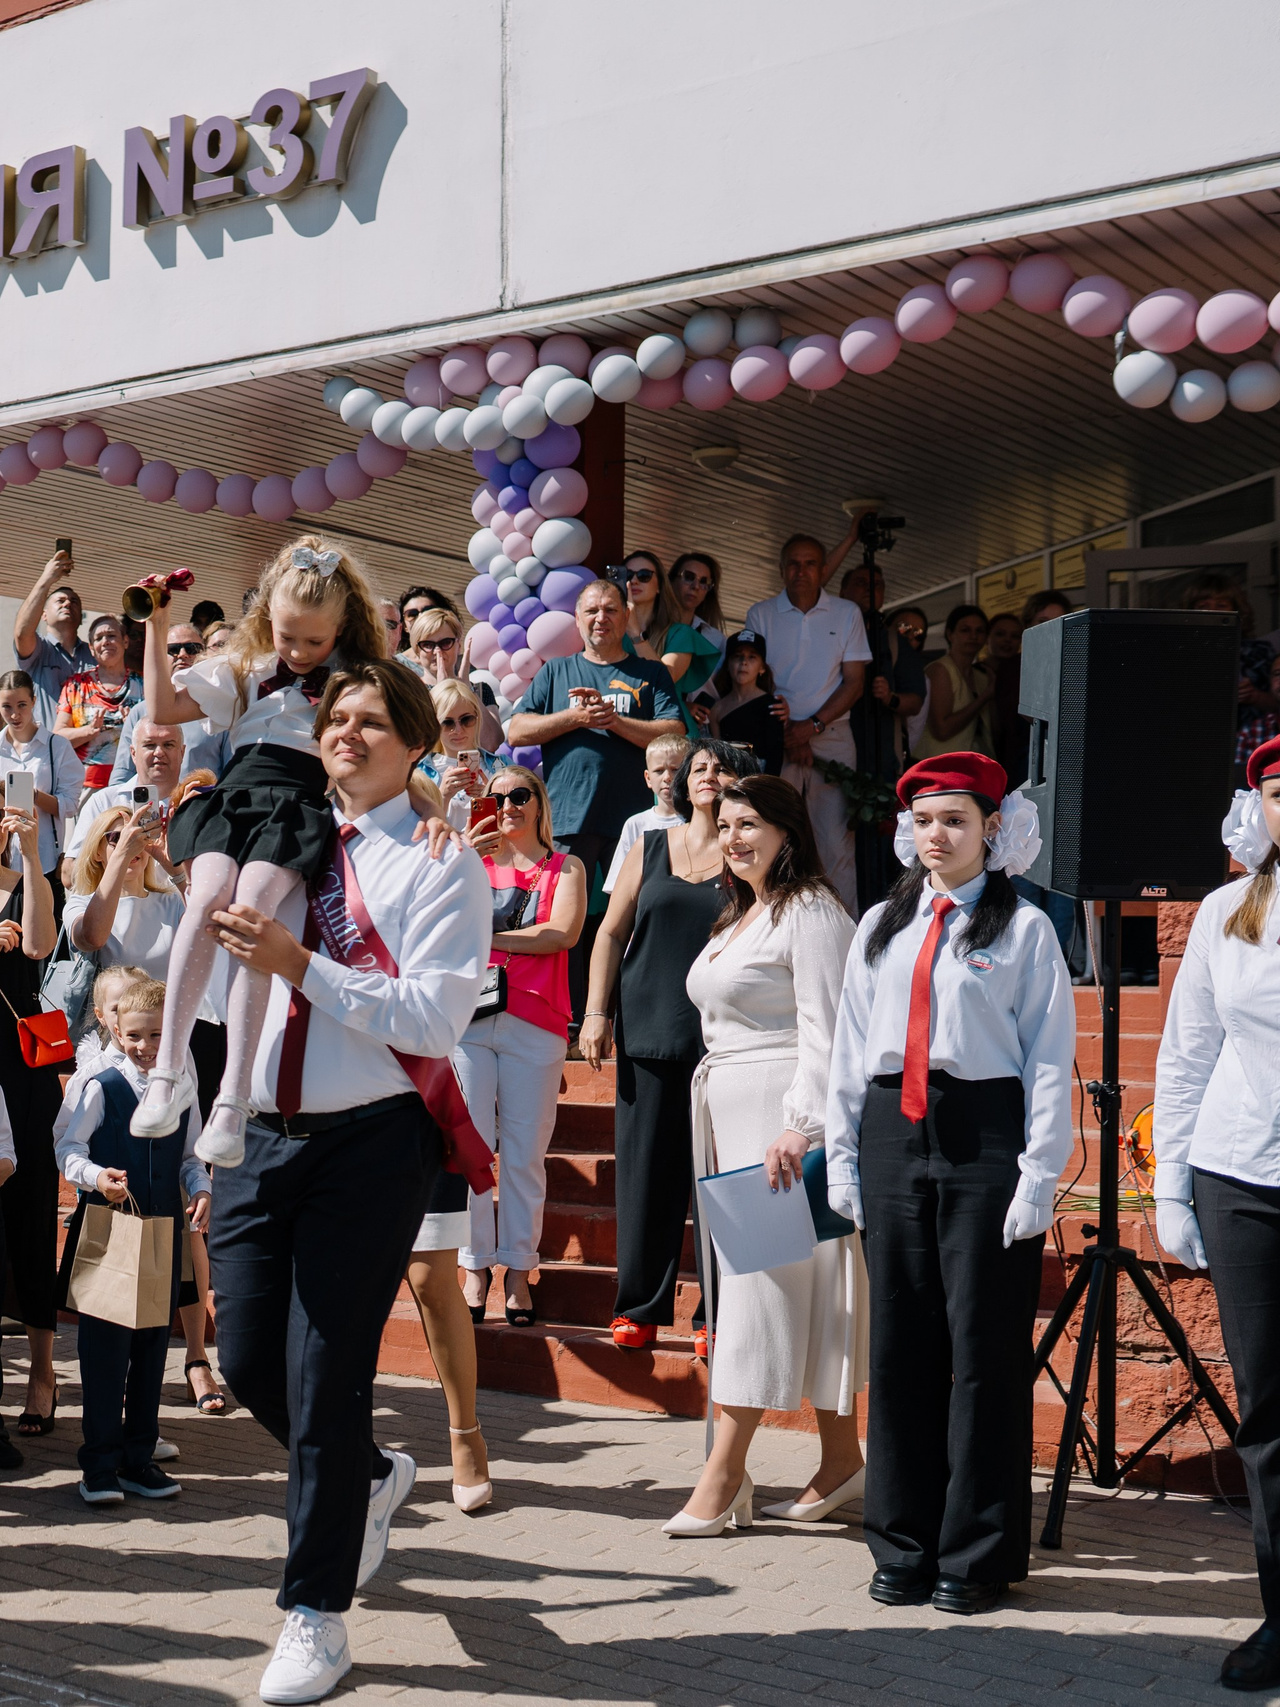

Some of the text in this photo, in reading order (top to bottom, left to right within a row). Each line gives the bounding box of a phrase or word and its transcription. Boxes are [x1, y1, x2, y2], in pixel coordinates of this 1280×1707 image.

[569, 693, 631, 713] PMA
[1141, 886, 1167, 895] ALTO
[320, 926, 340, 959] МИНСКА
